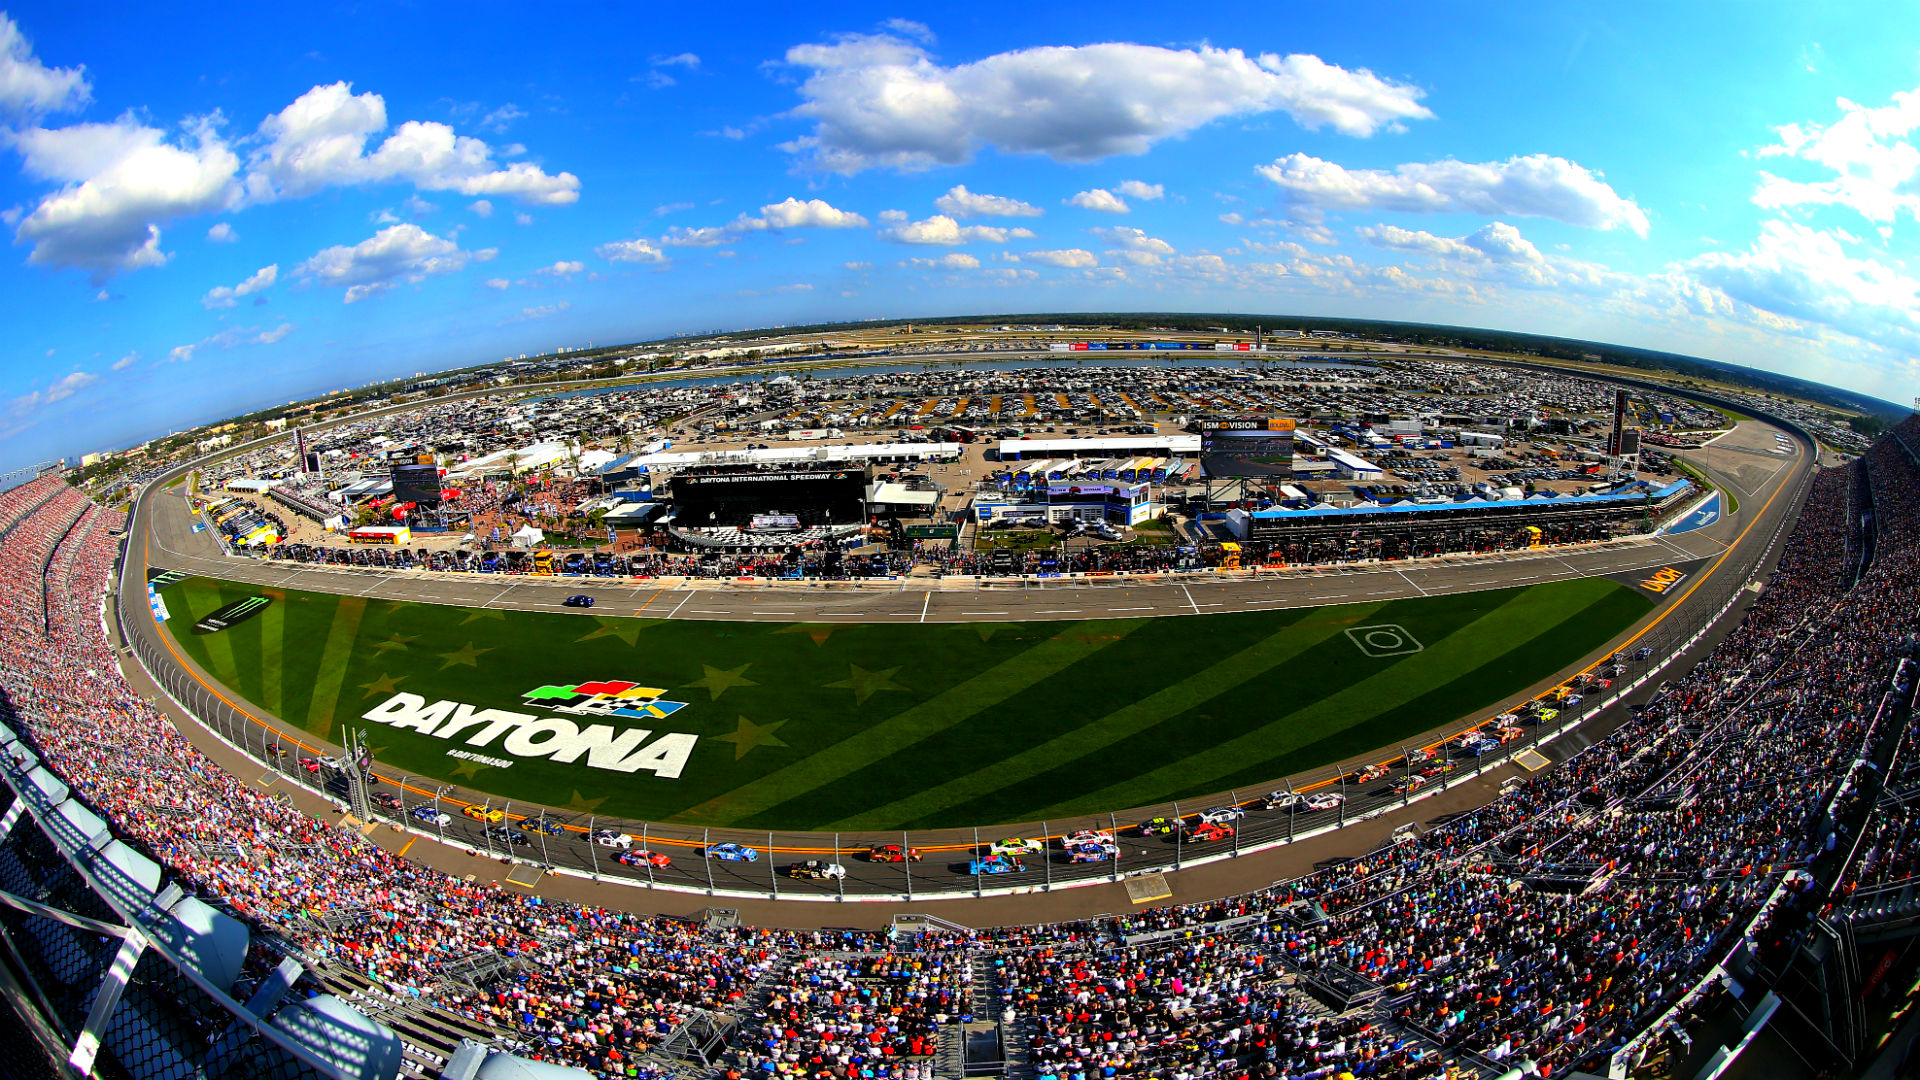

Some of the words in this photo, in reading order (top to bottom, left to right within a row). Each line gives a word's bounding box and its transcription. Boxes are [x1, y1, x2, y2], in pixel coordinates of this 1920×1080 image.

[1203, 421, 1219, 429] ISM
[1229, 421, 1258, 429] VISION
[731, 474, 788, 482] INTERNATIONAL
[790, 473, 831, 481] SPEEDWAY
[1639, 566, 1683, 592] UNOH
[361, 692, 699, 779] DAYTONA
[446, 749, 514, 769] #DAYTONA500
